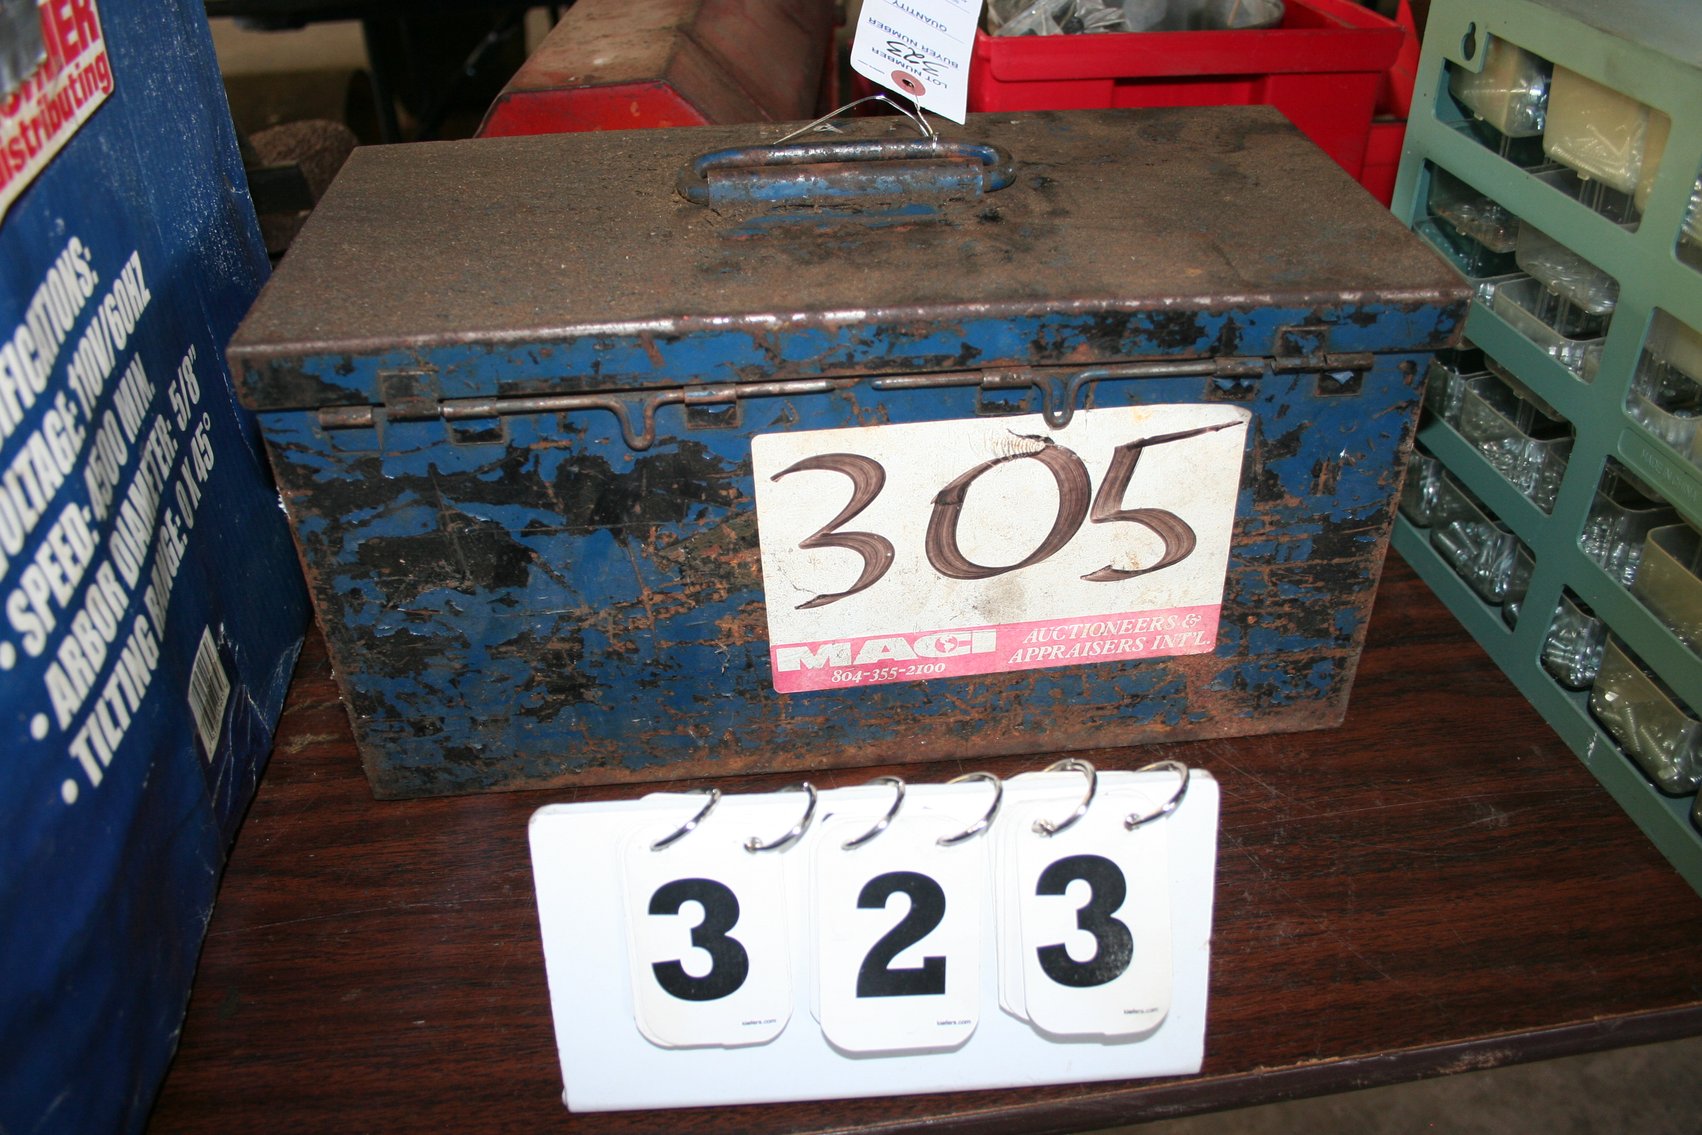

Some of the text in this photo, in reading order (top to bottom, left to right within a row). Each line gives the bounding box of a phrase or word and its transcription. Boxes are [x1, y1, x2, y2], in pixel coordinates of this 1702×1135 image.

[892, 0, 948, 32] QUANTITY
[868, 17, 959, 69] BUYER NUMBER
[871, 46, 948, 89] LOT NUMBER
[0, 236, 99, 453] IFICATIONS:
[0, 390, 86, 582] OLTAGE:
[6, 352, 155, 658] SPEED: 4500 MIN.
[770, 416, 1244, 610] 305
[44, 560, 129, 732] ARBOR
[109, 414, 178, 591] DIAMETER:
[69, 614, 159, 786] TILTING
[144, 507, 188, 642] RANGE:
[776, 631, 996, 672] MACI
[1008, 636, 1147, 664] APPRAISERS
[1022, 613, 1201, 643] AUCTIONEERS &
[831, 662, 946, 684] 804-355-2100
